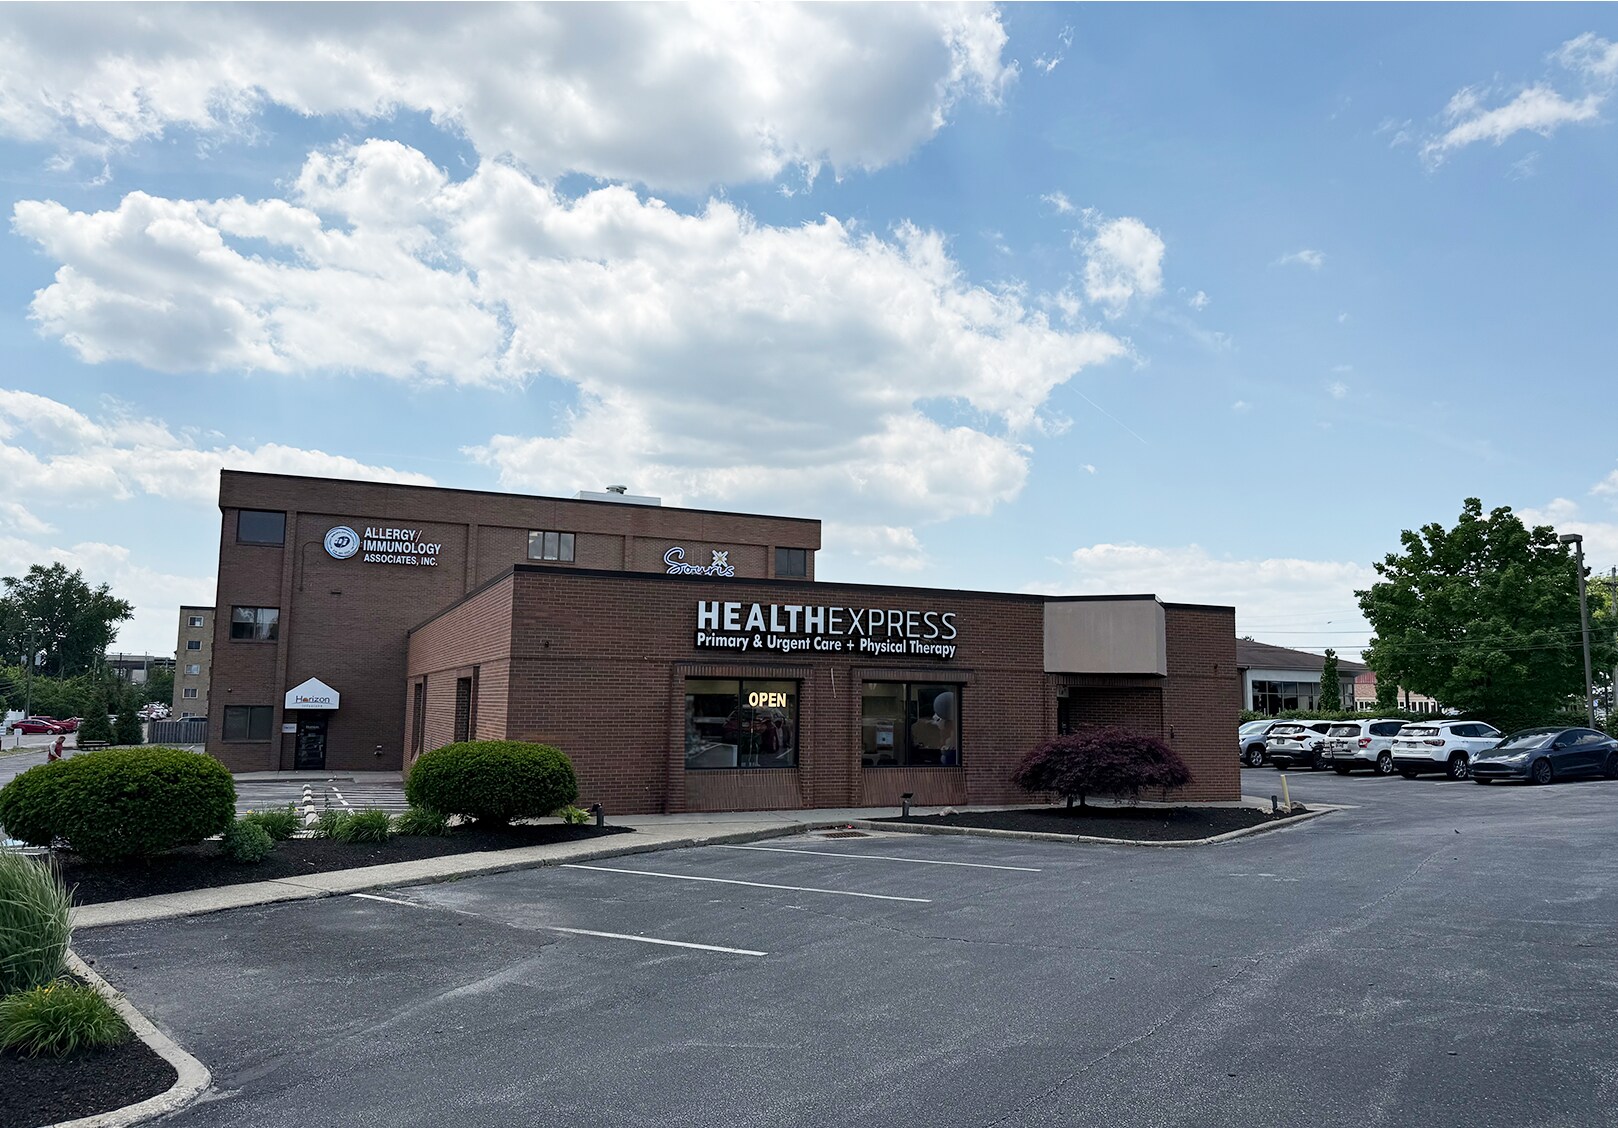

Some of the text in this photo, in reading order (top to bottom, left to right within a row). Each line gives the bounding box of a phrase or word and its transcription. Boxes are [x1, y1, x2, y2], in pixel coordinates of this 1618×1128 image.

[364, 527, 422, 542] ALLERGY/
[363, 540, 441, 555] IMMUNOLOGY
[363, 554, 438, 566] ASSOCIATES, INC.
[697, 600, 958, 640] HEALTHEXPRESS
[697, 632, 749, 651] Primary
[753, 634, 763, 648] &
[767, 634, 811, 652] Urgent
[813, 636, 842, 651] Care
[860, 638, 907, 656] Physical
[909, 640, 956, 658] Therapy
[295, 695, 330, 704] Horizon
[748, 691, 787, 708] OPEN
